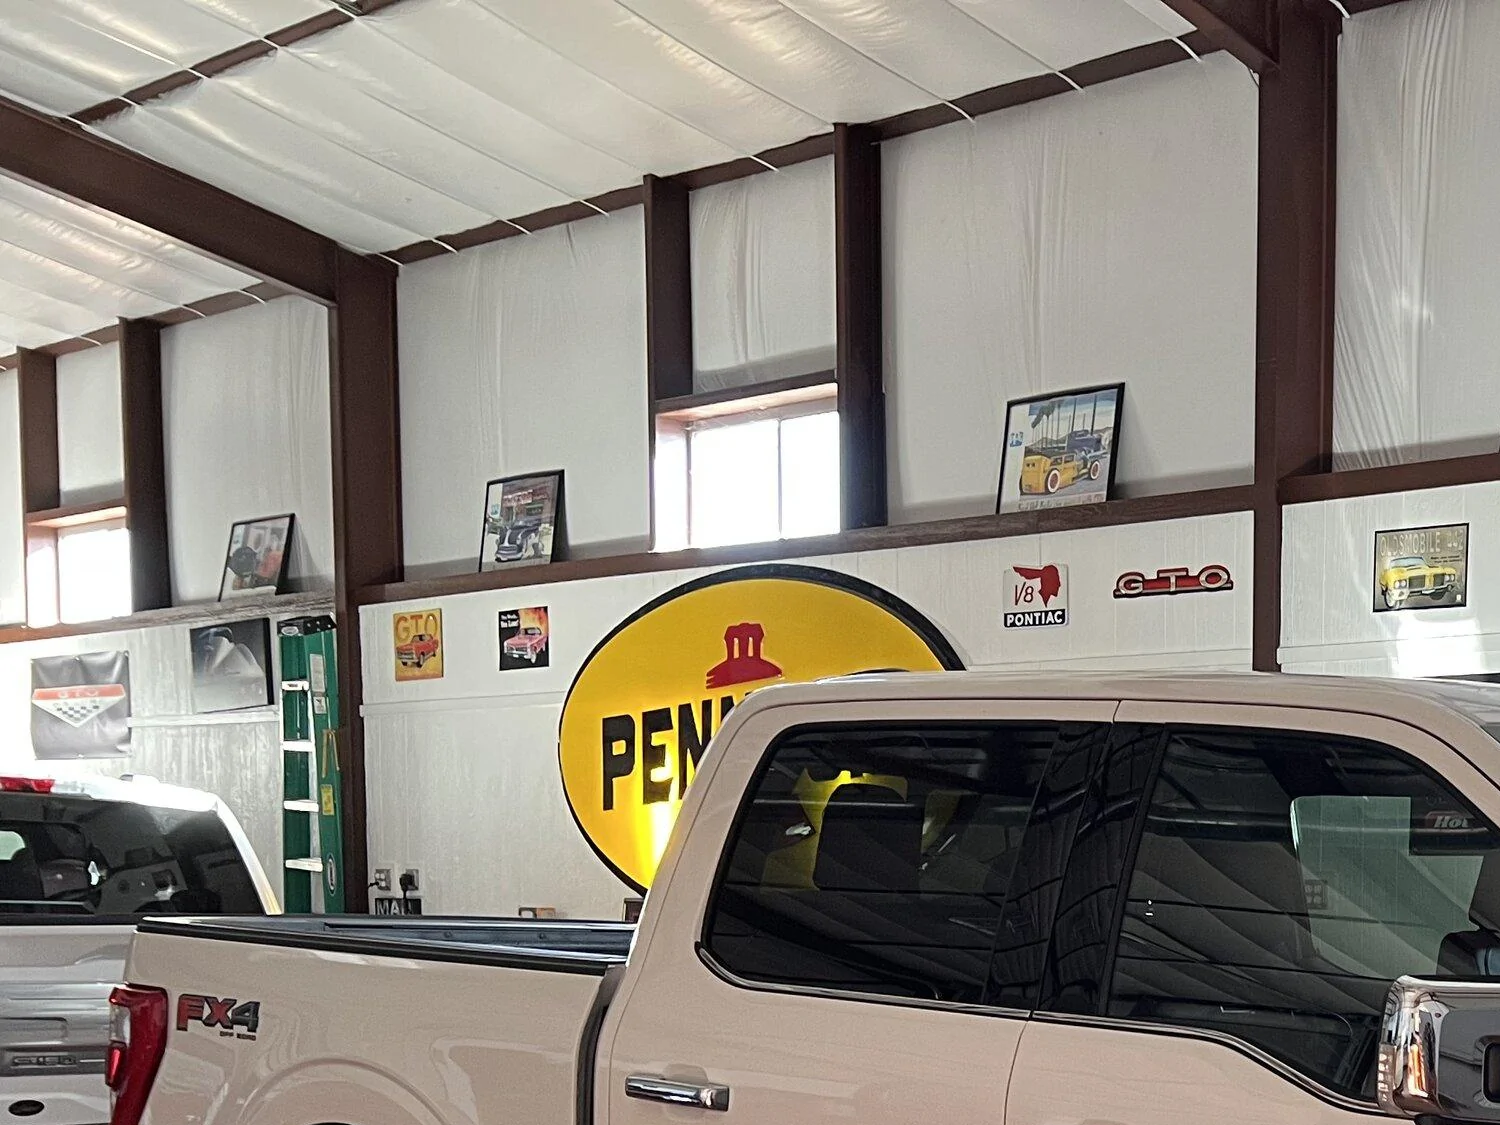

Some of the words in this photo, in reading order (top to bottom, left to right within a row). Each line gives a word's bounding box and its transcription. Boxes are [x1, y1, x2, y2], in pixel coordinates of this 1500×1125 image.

[1380, 531, 1441, 557] OLDSMOBILE
[1014, 581, 1035, 606] V8
[1116, 564, 1230, 596] GTO
[395, 612, 438, 642] GTO
[1006, 610, 1064, 627] PONTIAC
[176, 993, 261, 1033] FX4
